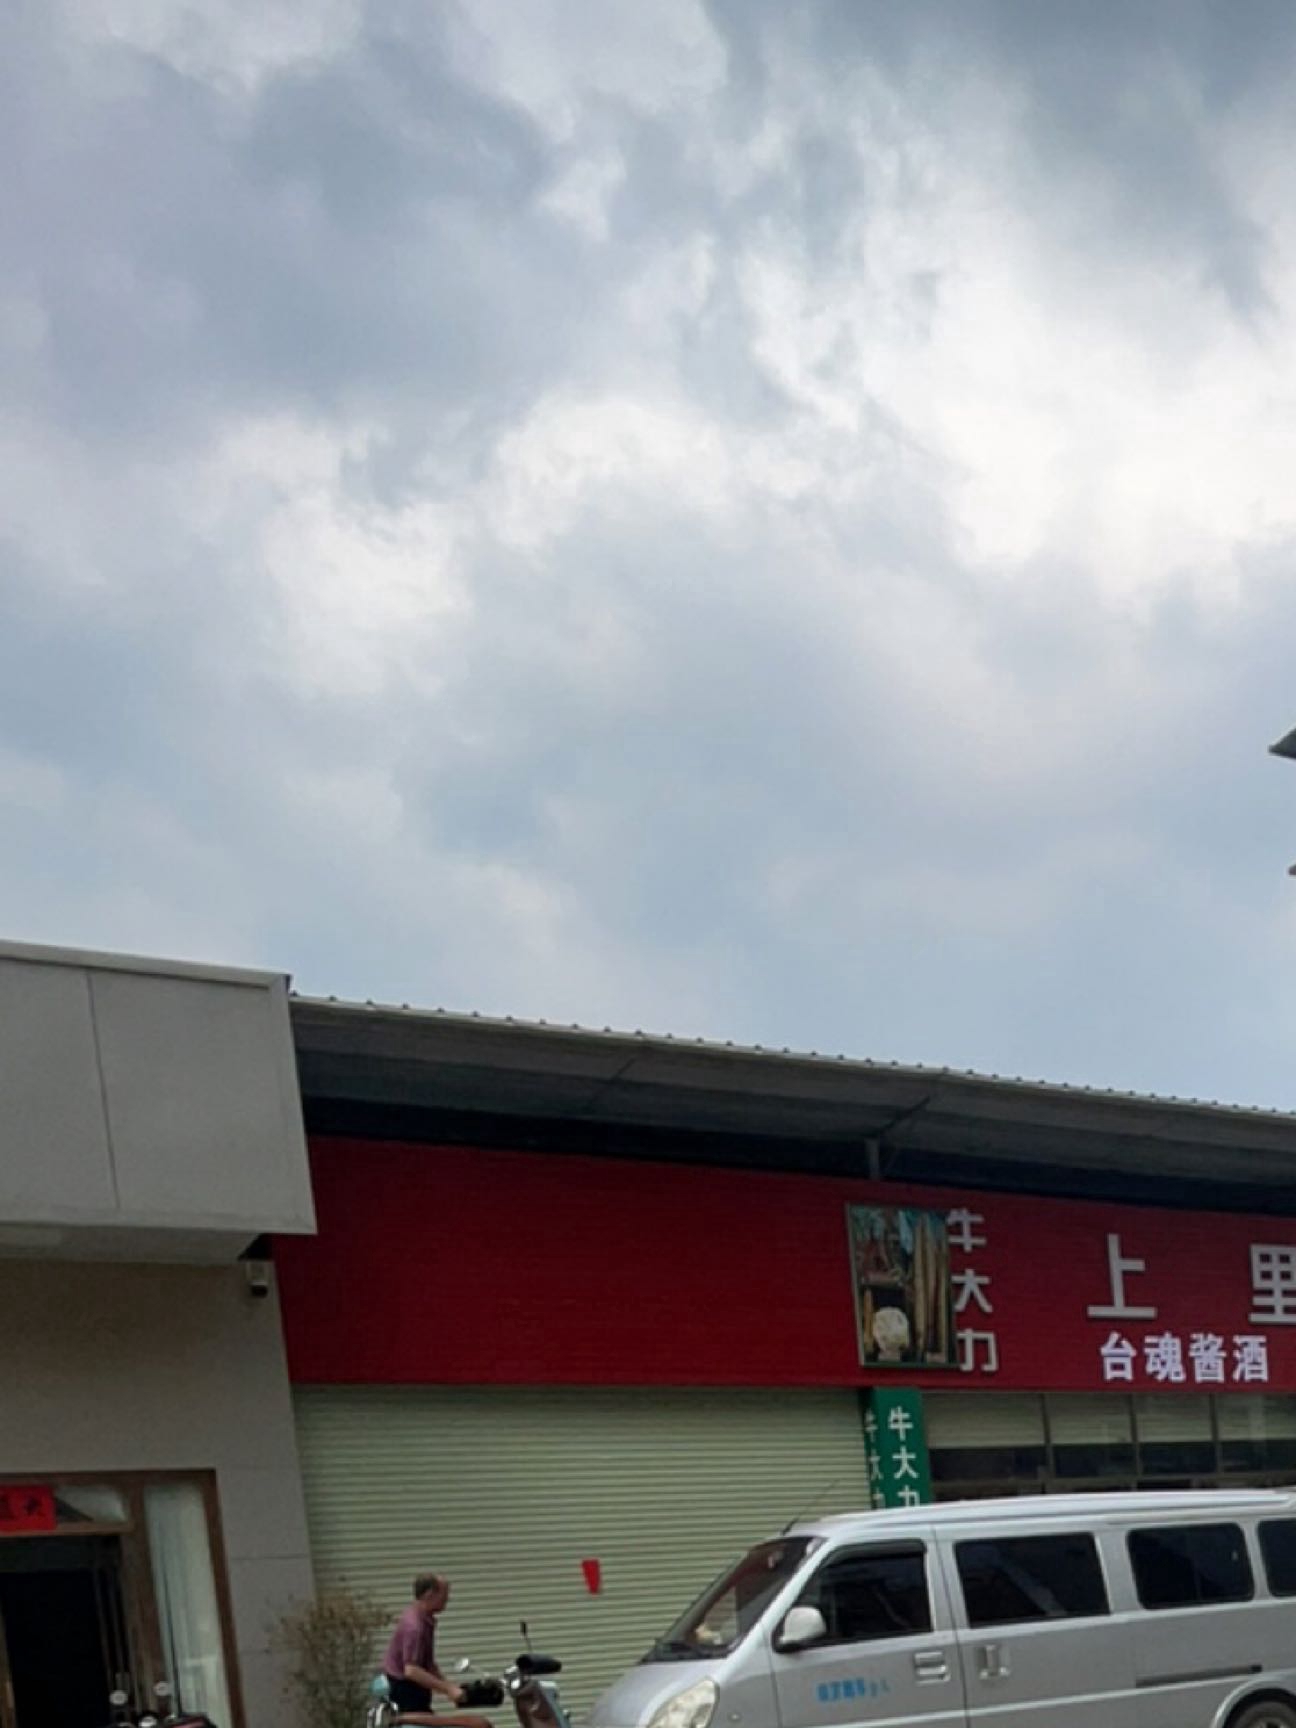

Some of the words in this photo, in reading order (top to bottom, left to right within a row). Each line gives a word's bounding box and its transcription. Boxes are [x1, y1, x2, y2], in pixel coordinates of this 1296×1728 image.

[947, 1208, 998, 1372] 牛大力
[1100, 1332, 1269, 1383] 台魂酱酒
